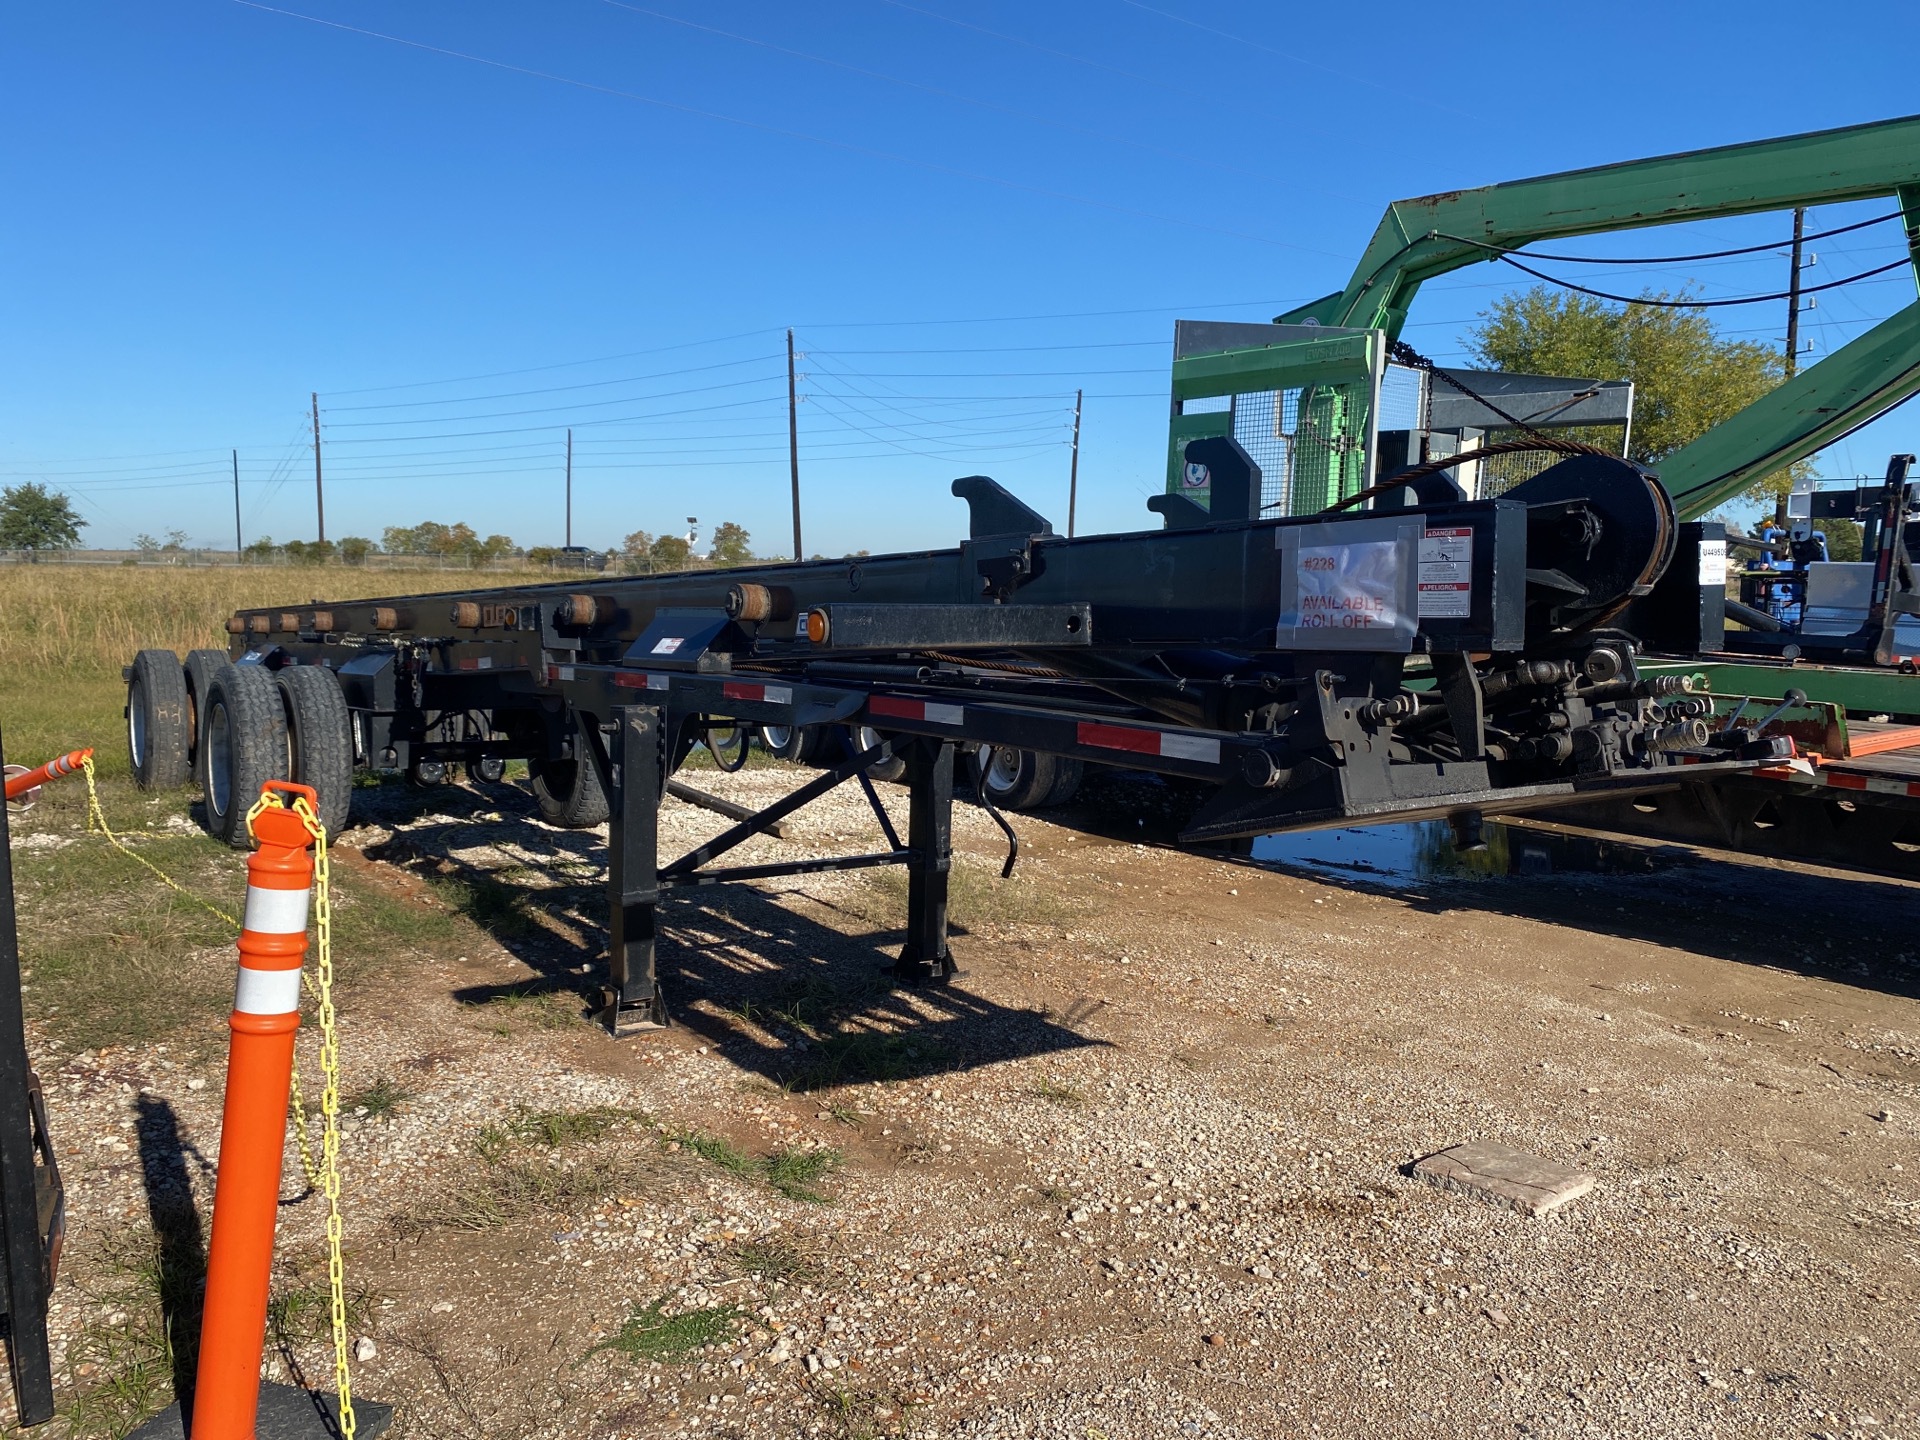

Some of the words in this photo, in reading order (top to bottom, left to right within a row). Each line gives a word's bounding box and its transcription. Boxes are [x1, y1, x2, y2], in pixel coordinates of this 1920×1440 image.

[1432, 529, 1457, 537] DANGER
[1304, 557, 1335, 572] #228
[1302, 595, 1384, 611] AVAILABLE
[1301, 614, 1338, 628] ROLL
[1342, 614, 1374, 629] OFF
